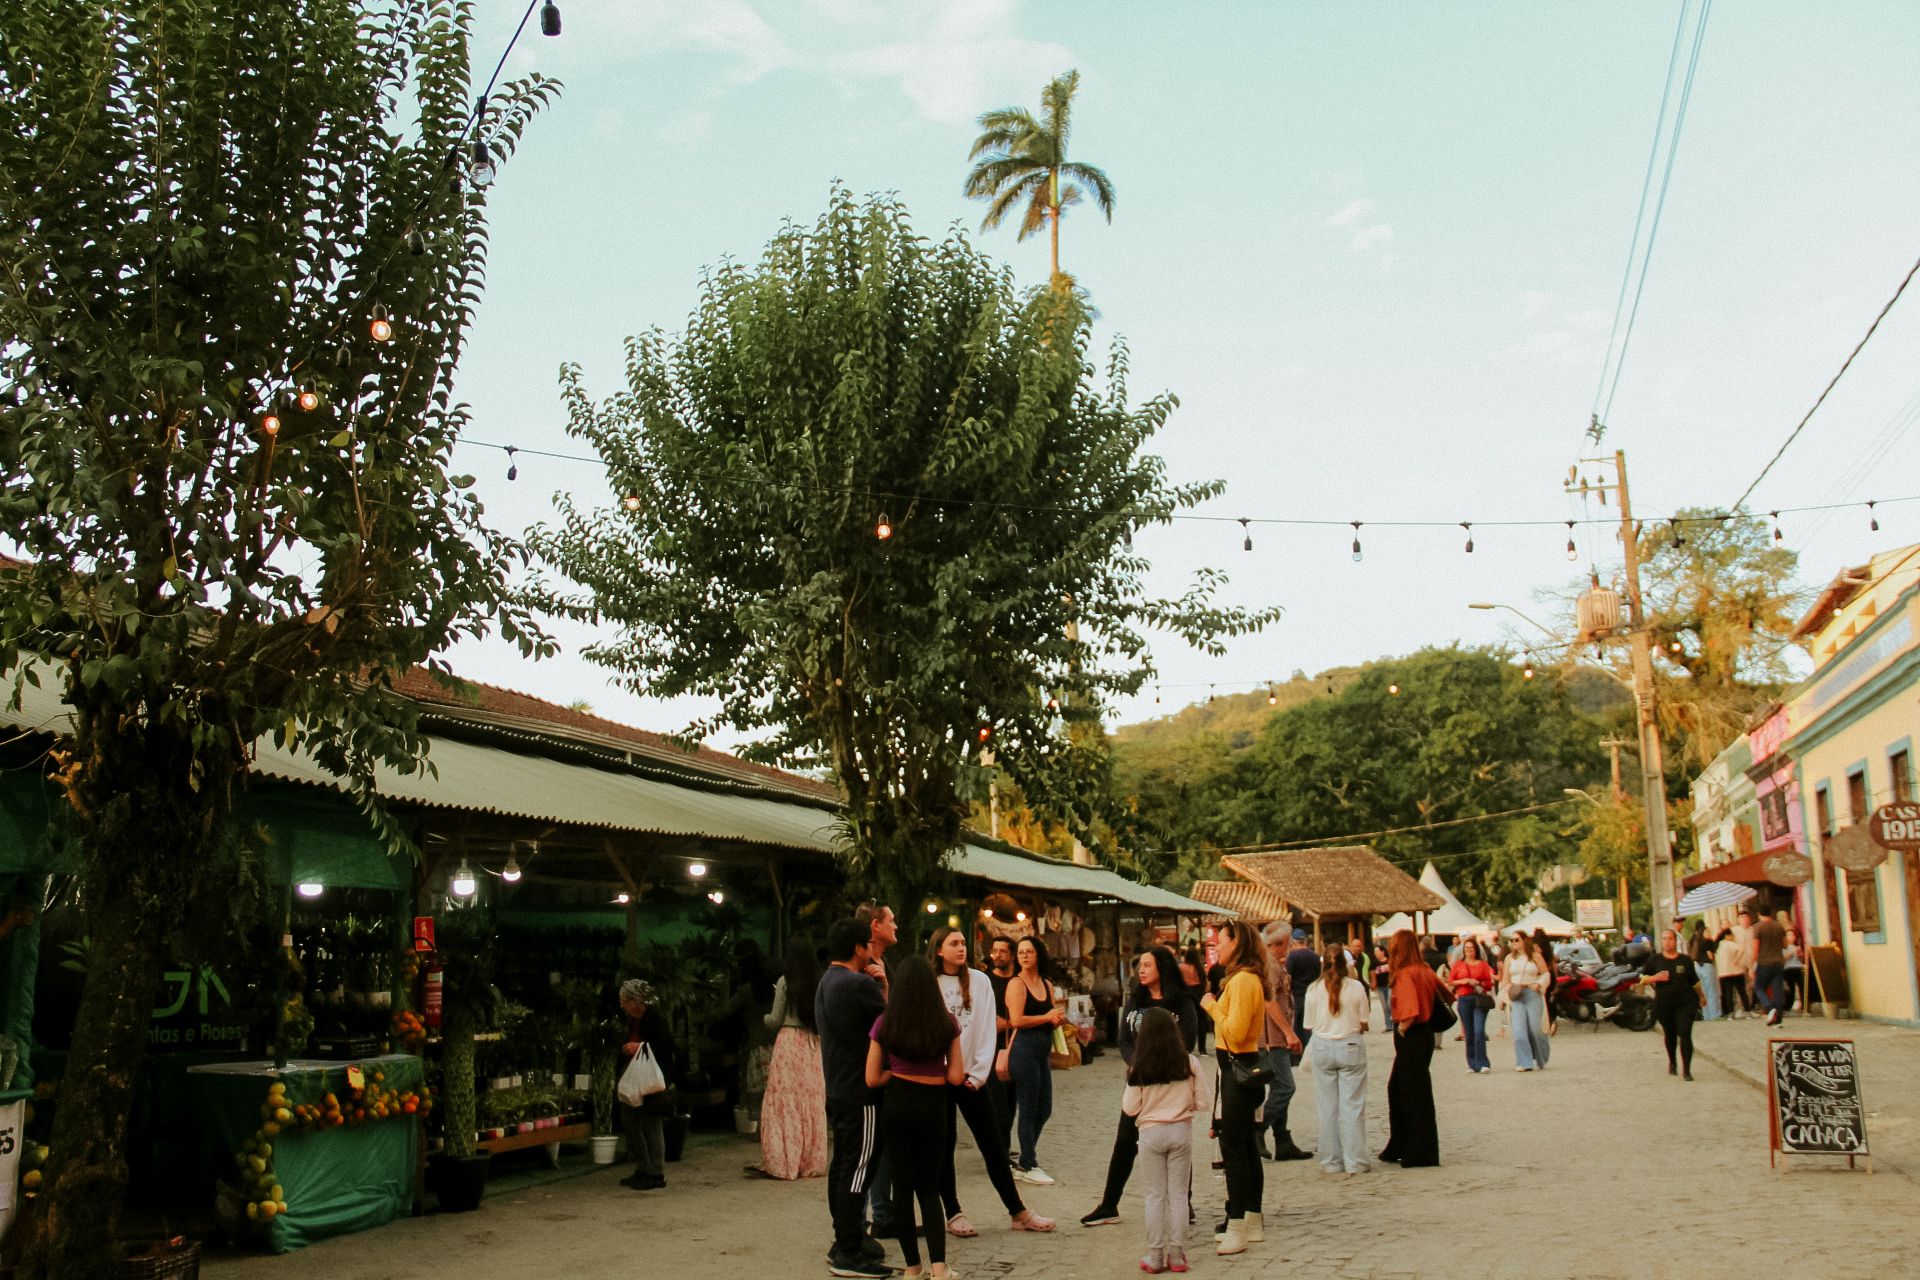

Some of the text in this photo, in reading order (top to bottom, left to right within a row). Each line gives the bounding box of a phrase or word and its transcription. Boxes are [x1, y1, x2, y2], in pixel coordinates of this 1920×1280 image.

[1878, 806, 1920, 821] CAS
[147, 1024, 180, 1045] ntas
[185, 1027, 196, 1042] e
[1792, 1050, 1800, 1062] E
[1801, 1049, 1817, 1062] SE
[1818, 1050, 1828, 1063] A
[1817, 1065, 1834, 1076] TE
